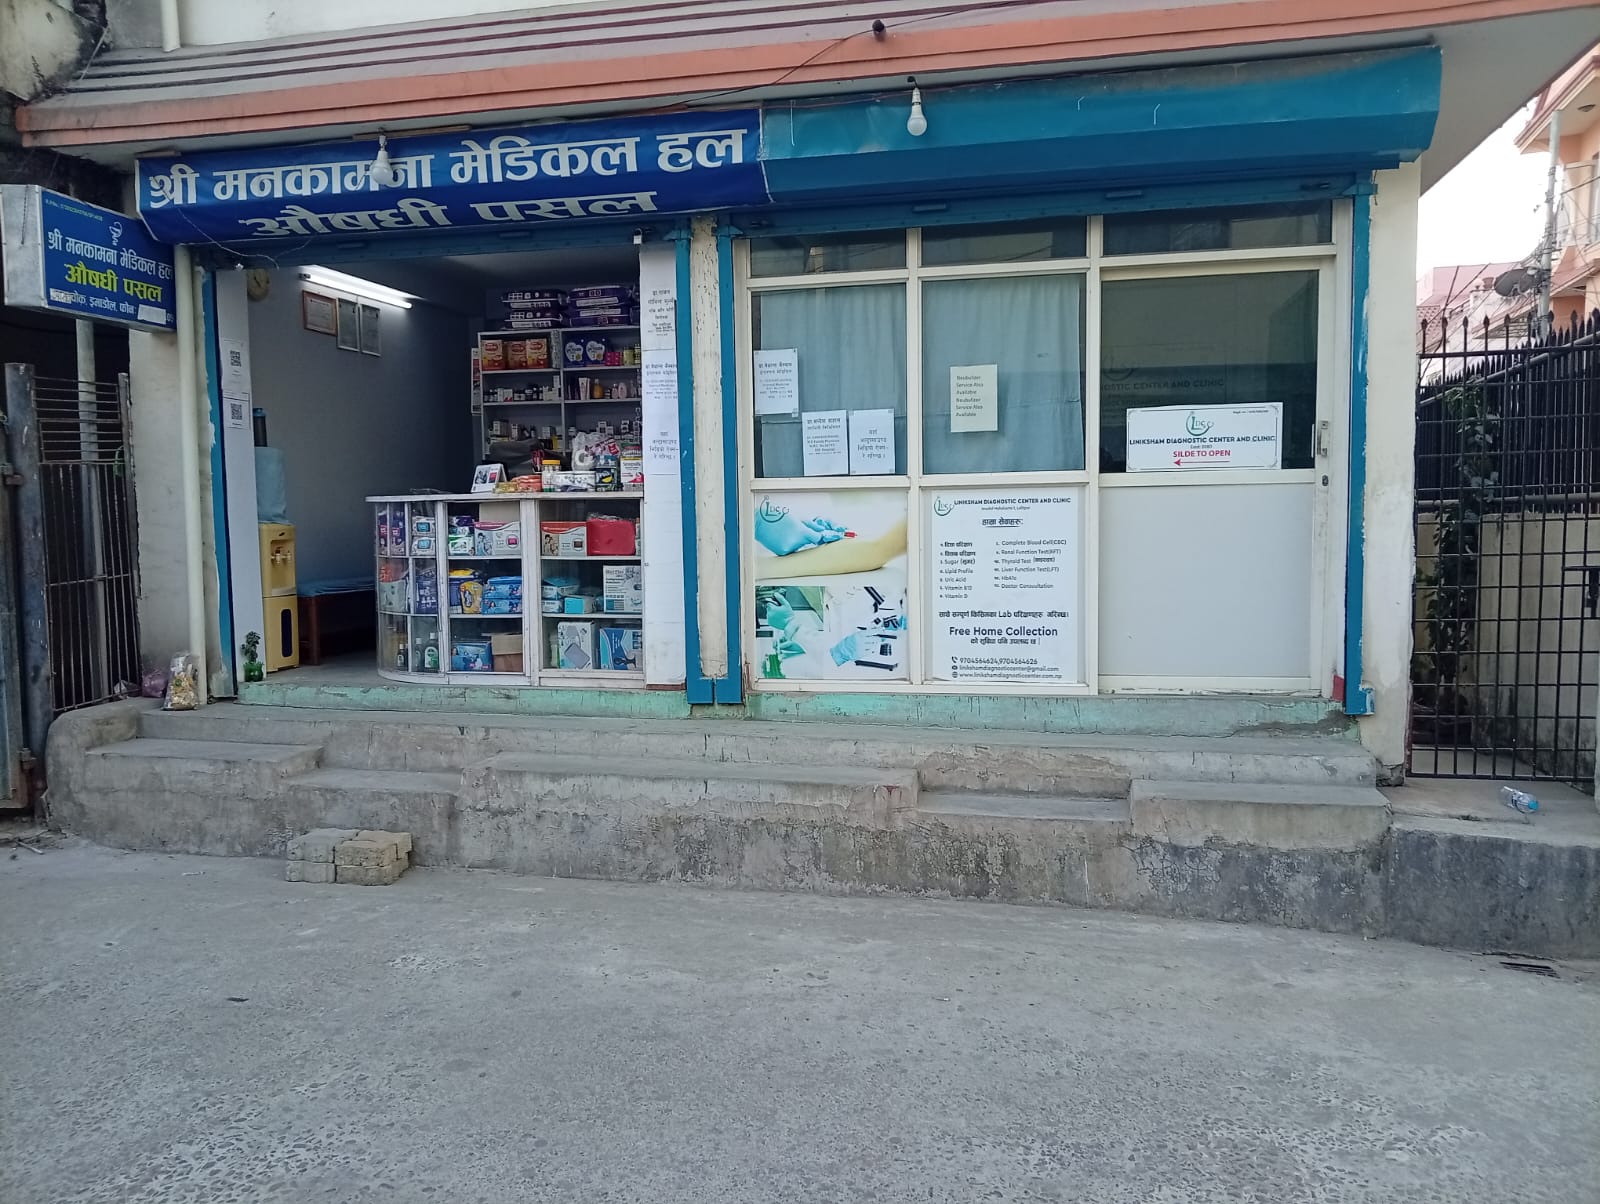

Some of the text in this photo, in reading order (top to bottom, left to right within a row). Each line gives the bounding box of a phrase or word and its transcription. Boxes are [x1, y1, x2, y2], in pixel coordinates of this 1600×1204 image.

[149, 129, 747, 208] श्री मनकामना मेडिकल हल
[239, 191, 657, 236] औषधी पसल
[47, 228, 62, 250] श्री
[65, 237, 117, 265] मनकामना
[120, 248, 156, 275] मेडिकल
[123, 278, 162, 303] पसल
[1208, 449, 1231, 457] OPEN
[998, 610, 1012, 618] Lab
[949, 625, 1058, 636] Free Home Collection
